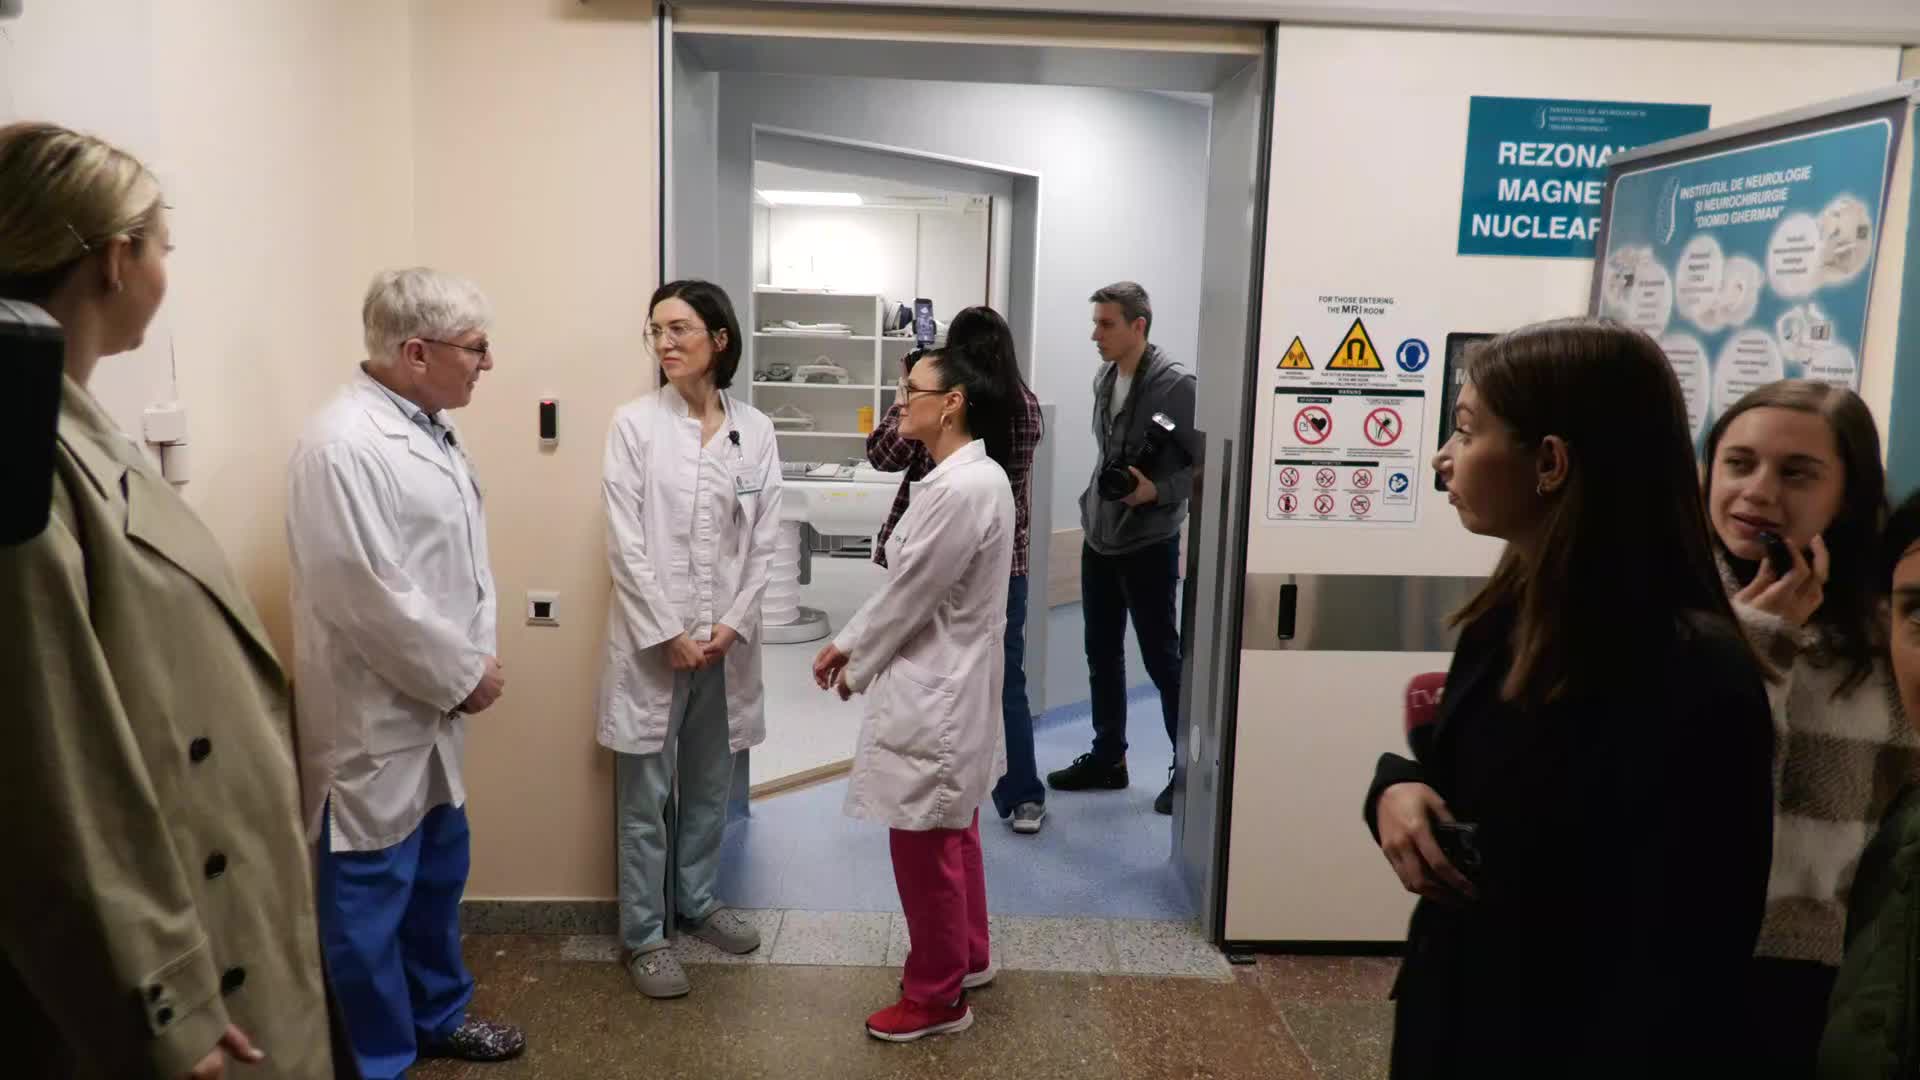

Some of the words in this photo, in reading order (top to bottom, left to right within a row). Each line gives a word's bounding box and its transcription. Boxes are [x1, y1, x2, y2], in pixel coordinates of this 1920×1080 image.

[1498, 141, 1640, 169] REZONA
[1497, 177, 1608, 205] MAGNE
[1680, 181, 1729, 200] INSTITUTUL
[1730, 177, 1744, 192] DE
[1745, 165, 1813, 190] NEUROLOGIE
[1703, 187, 1789, 212] NEUROCHIRURGIE
[1318, 295, 1333, 304] FOR
[1334, 295, 1357, 305] THOSE
[1359, 296, 1394, 305] ENTERING
[1327, 305, 1341, 314] THE
[1341, 304, 1363, 315] MRI
[1363, 307, 1385, 315] ROOM
